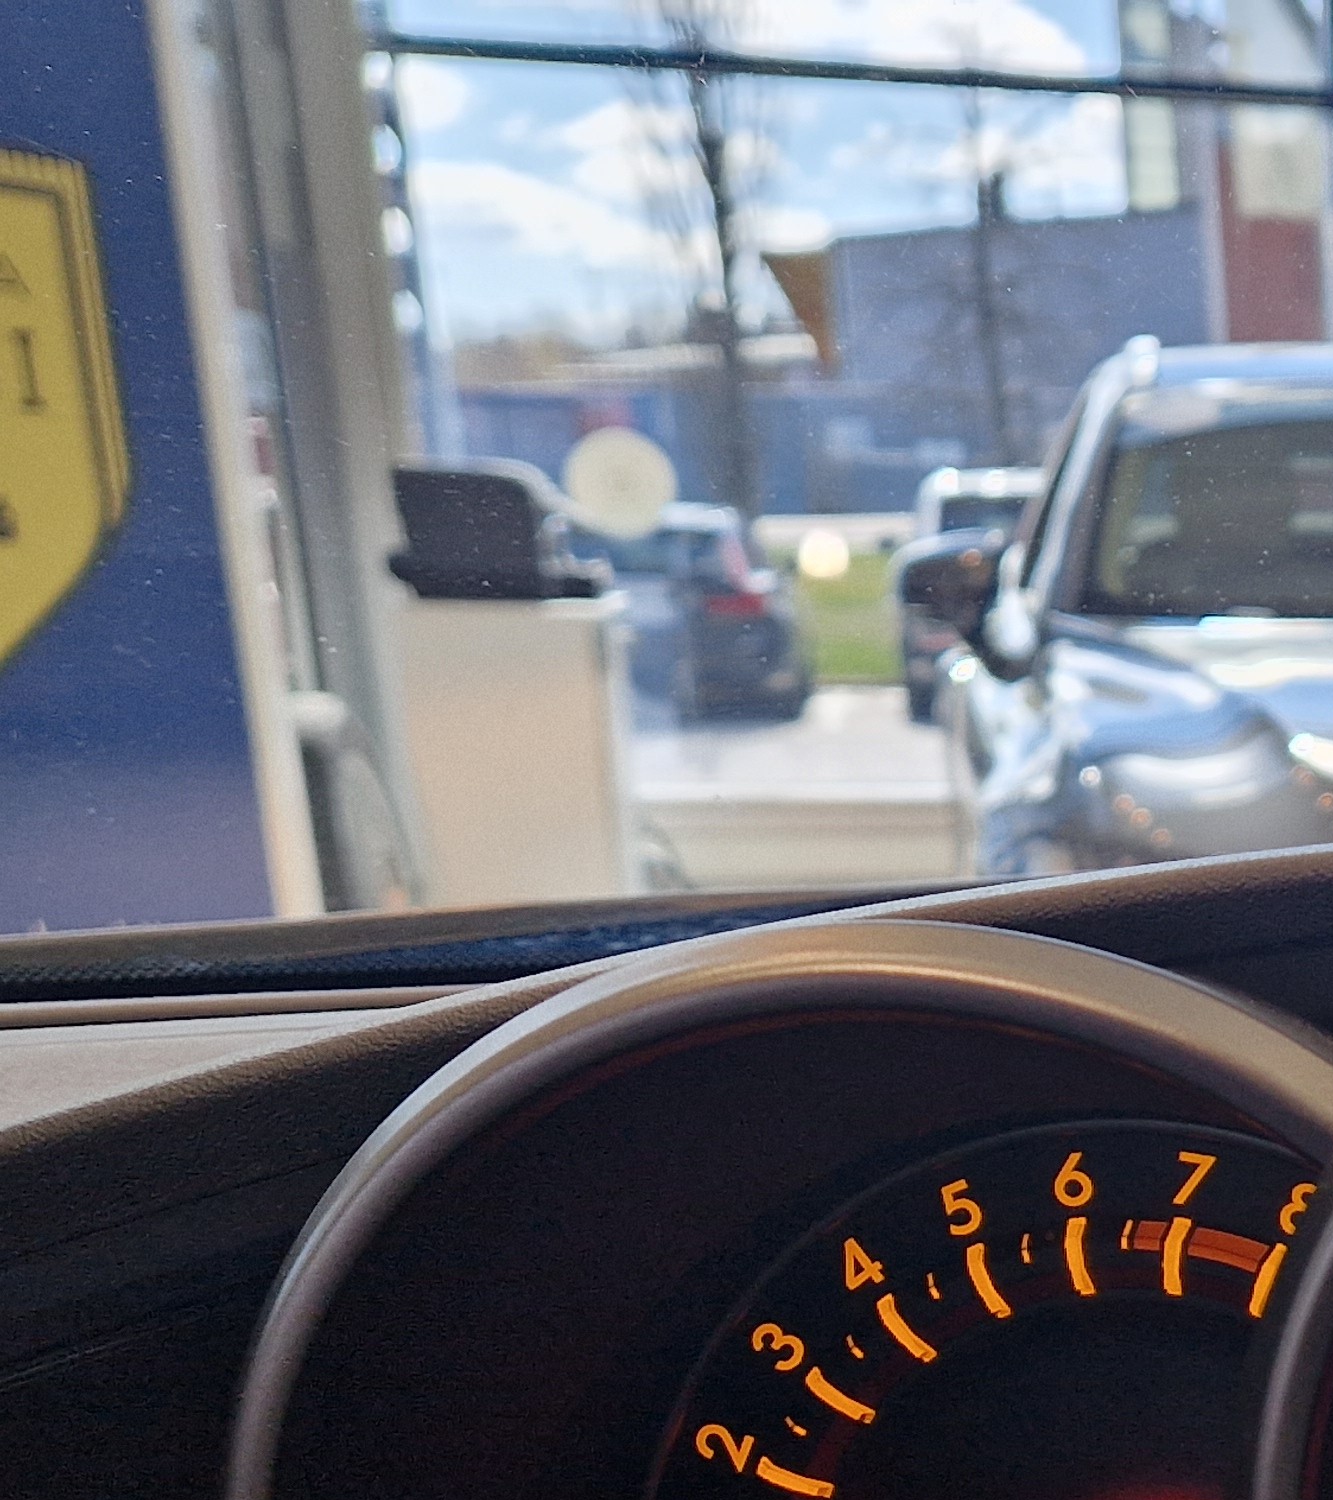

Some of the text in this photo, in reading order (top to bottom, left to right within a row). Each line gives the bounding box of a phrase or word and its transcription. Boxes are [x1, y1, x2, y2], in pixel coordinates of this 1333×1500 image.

[1054, 1151, 1094, 1208] 6
[1172, 1151, 1217, 1205] 7
[940, 1179, 983, 1236] 5
[843, 1237, 885, 1291] 4
[751, 1323, 805, 1371] 3
[695, 1423, 755, 1473] 2
